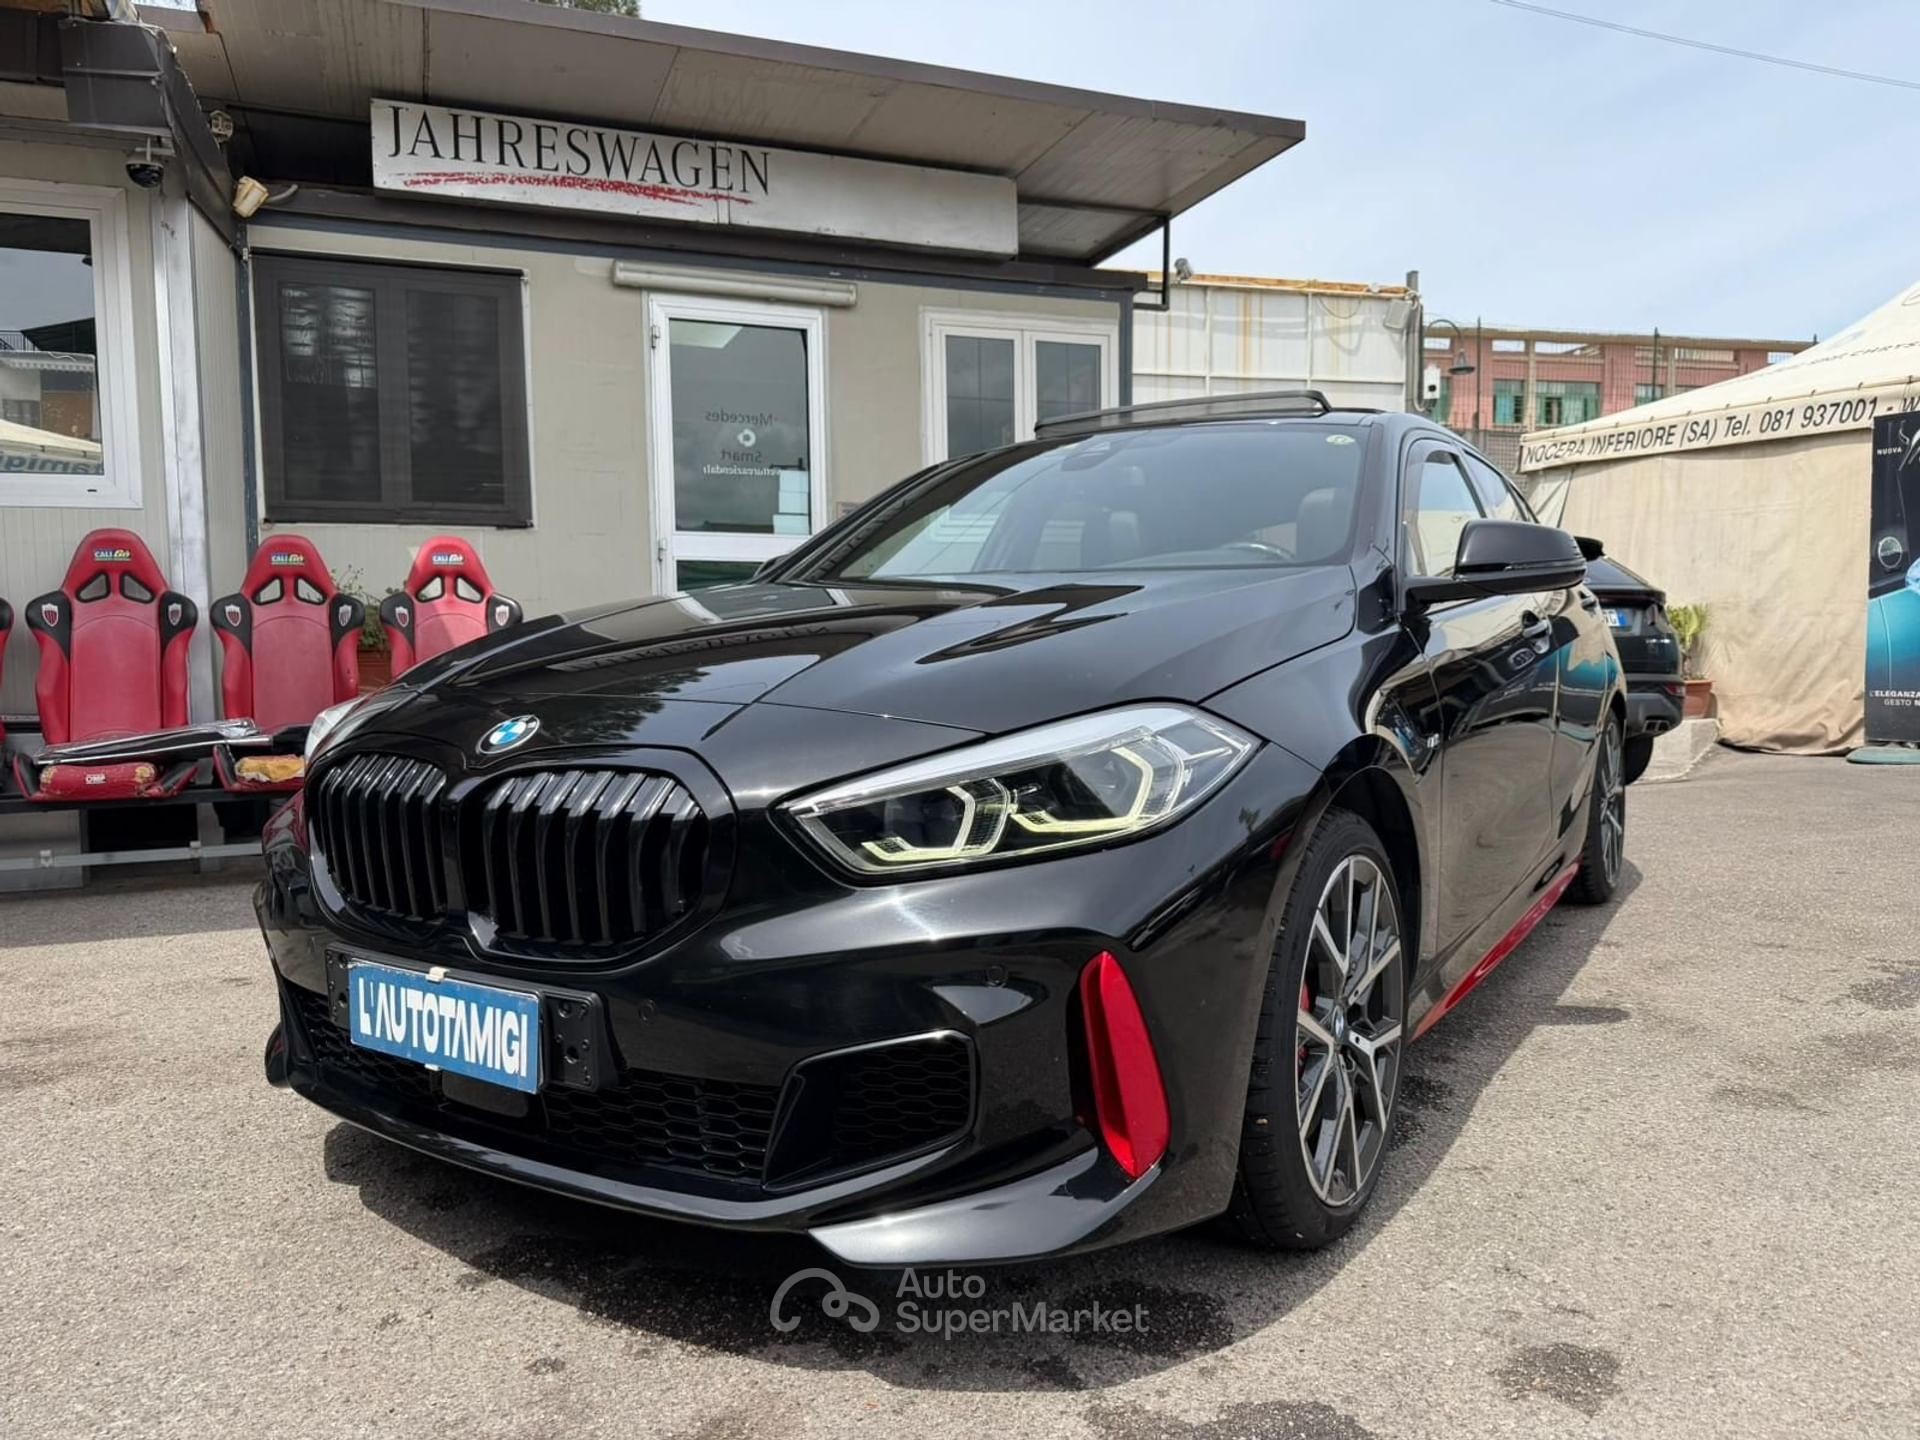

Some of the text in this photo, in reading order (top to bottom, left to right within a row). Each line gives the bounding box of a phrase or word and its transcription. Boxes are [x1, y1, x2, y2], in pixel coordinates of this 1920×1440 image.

[388, 105, 770, 195] JAHRESWAGEN
[1523, 439, 1585, 465] NOCERA
[1587, 424, 1678, 457] INFERIORE
[1680, 419, 1718, 448] (SA)
[1724, 414, 1751, 438] Tel.
[1759, 408, 1795, 434] 081
[1801, 396, 1878, 428] 937001
[1877, 447, 1902, 455] NUOVA
[358, 976, 528, 1077] L'AUTOTAMIGI
